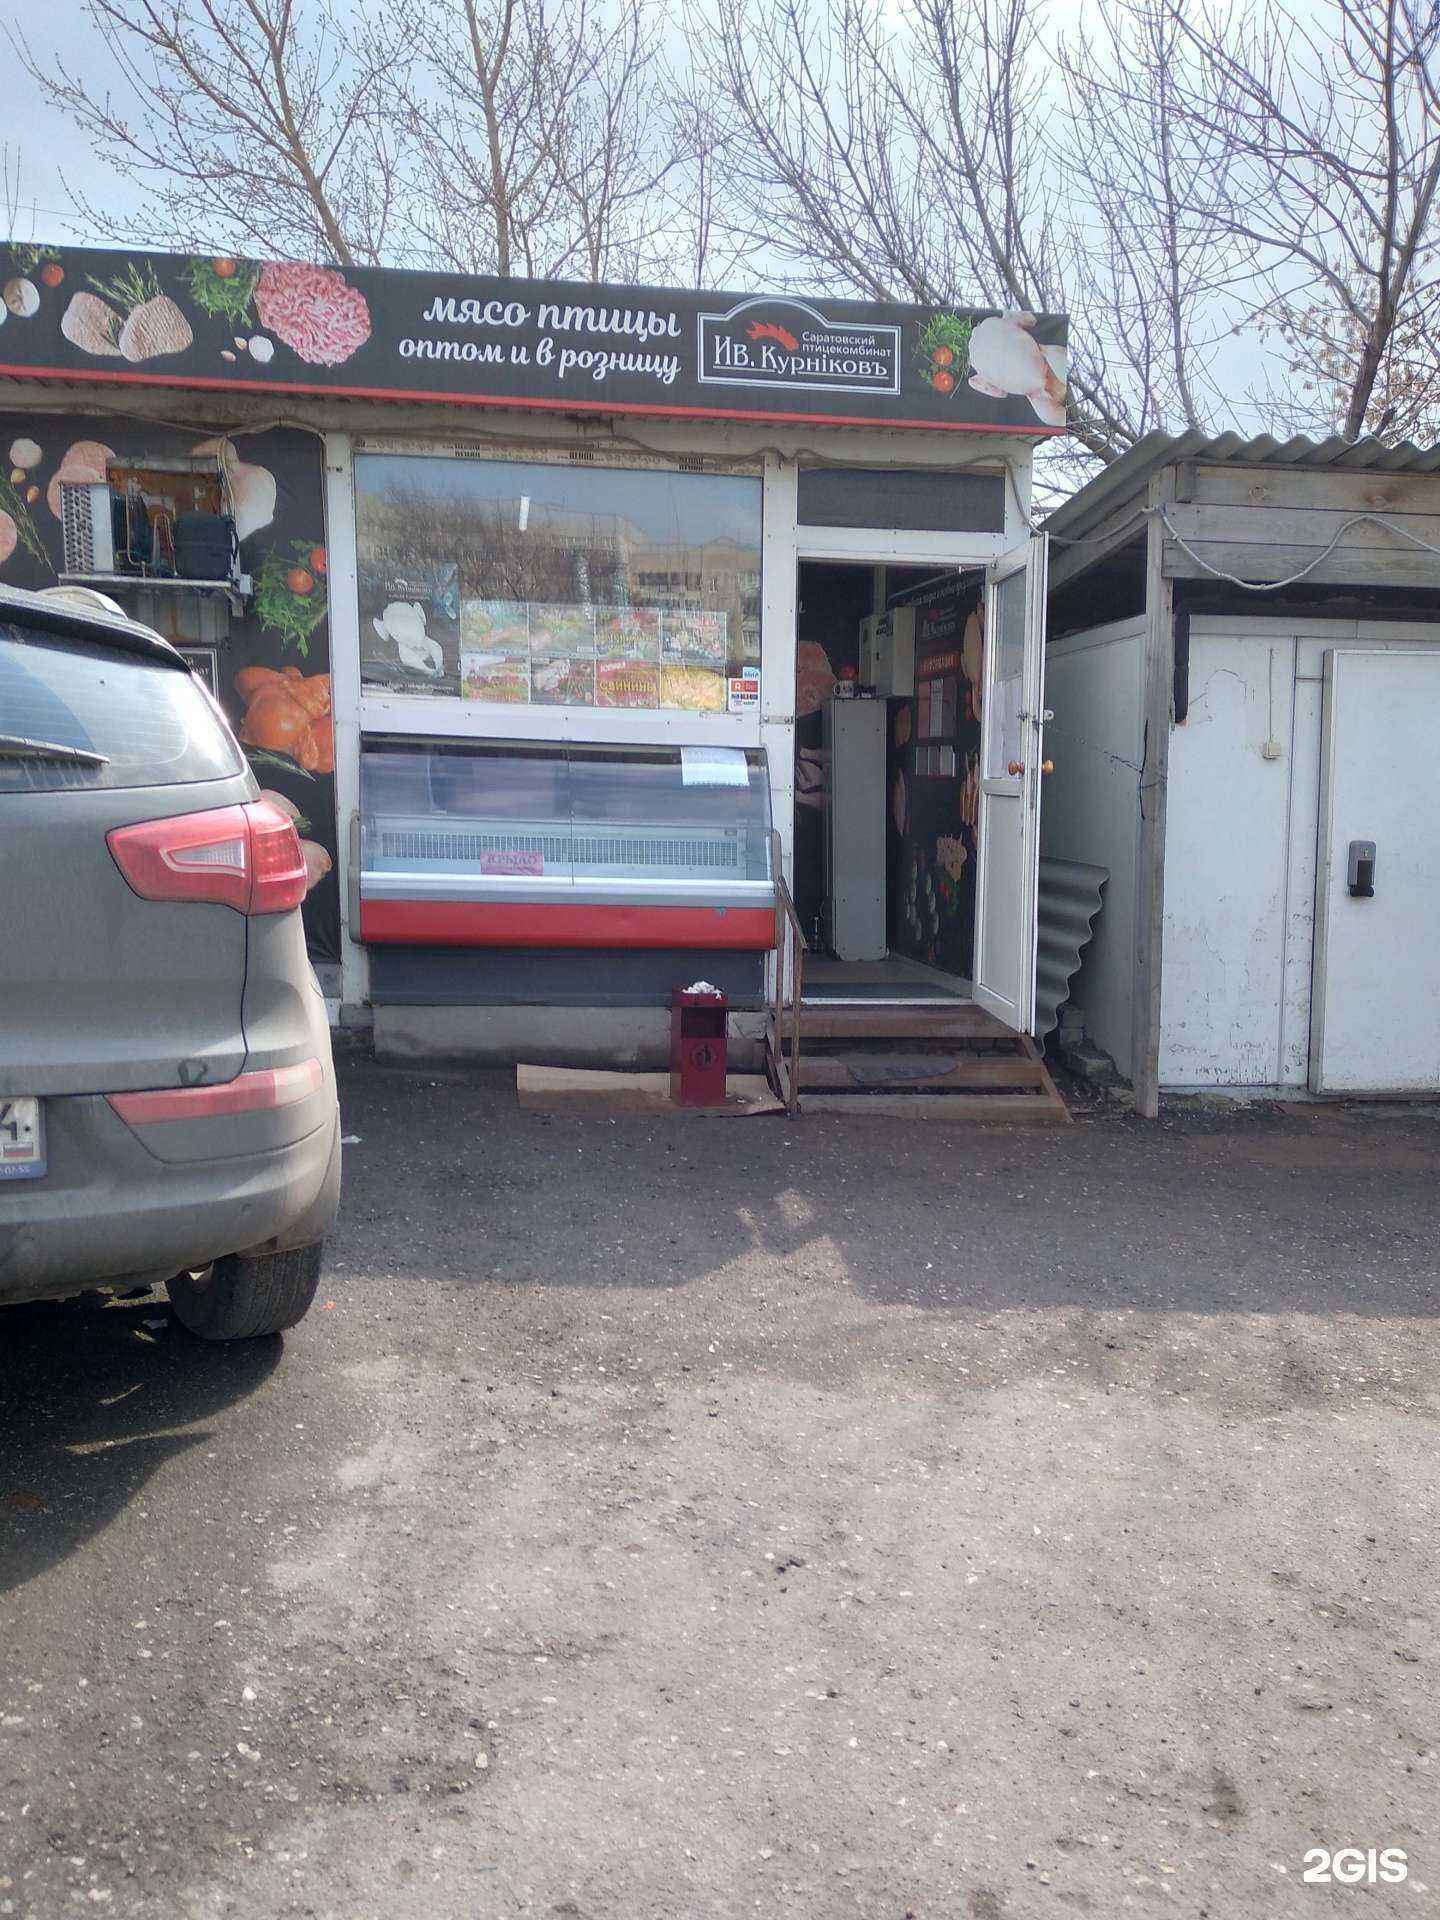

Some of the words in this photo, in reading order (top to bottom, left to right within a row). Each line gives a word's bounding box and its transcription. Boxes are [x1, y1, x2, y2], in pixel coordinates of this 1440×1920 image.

[423, 296, 531, 327] мясо
[537, 303, 682, 342] птицы
[802, 331, 876, 346] Саратовский
[399, 337, 505, 362] оптом
[510, 346, 531, 365] и
[536, 337, 555, 366] в
[558, 348, 682, 384] розницу
[714, 335, 755, 367] Ив.
[761, 345, 888, 376] Курніковъ
[802, 343, 892, 358] птицекомбинат
